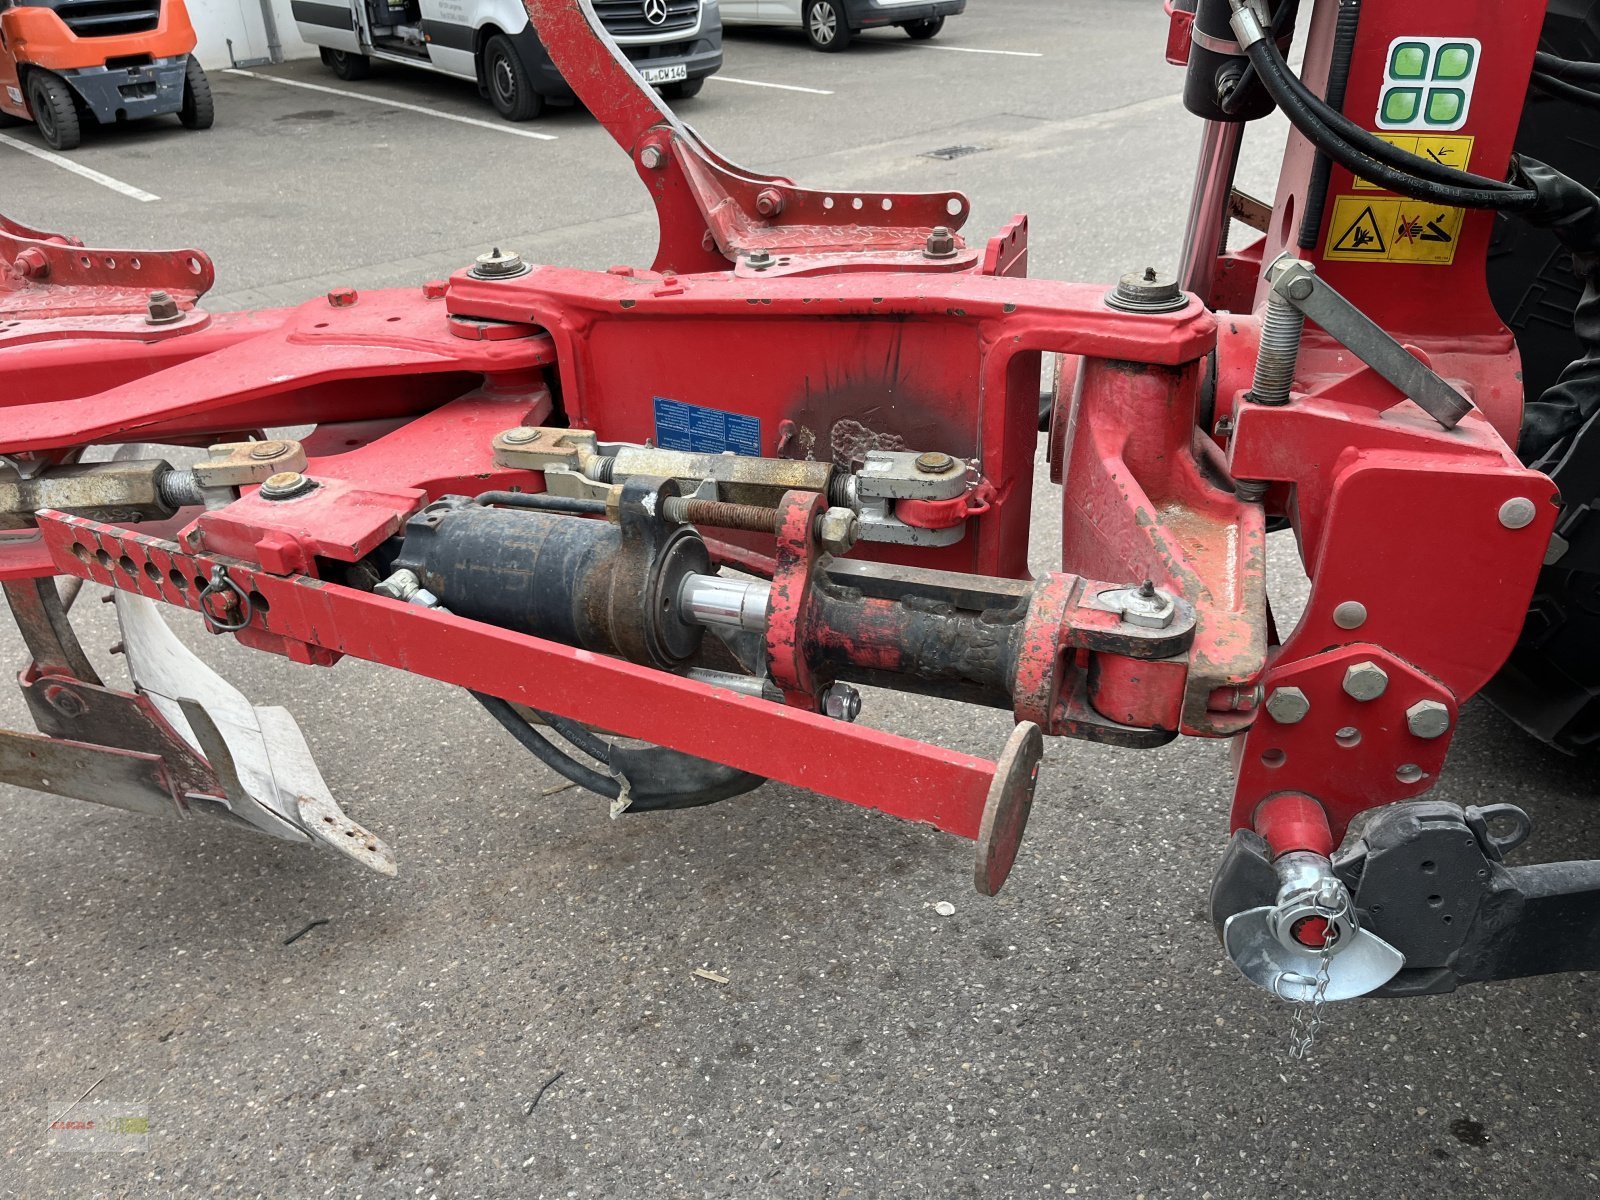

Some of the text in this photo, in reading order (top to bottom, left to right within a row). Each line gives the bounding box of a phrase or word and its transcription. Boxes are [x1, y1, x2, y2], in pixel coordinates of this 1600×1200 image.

[658, 69, 670, 80] CW
[671, 67, 686, 79] 146
[1428, 184, 1461, 198] FLEXOR
